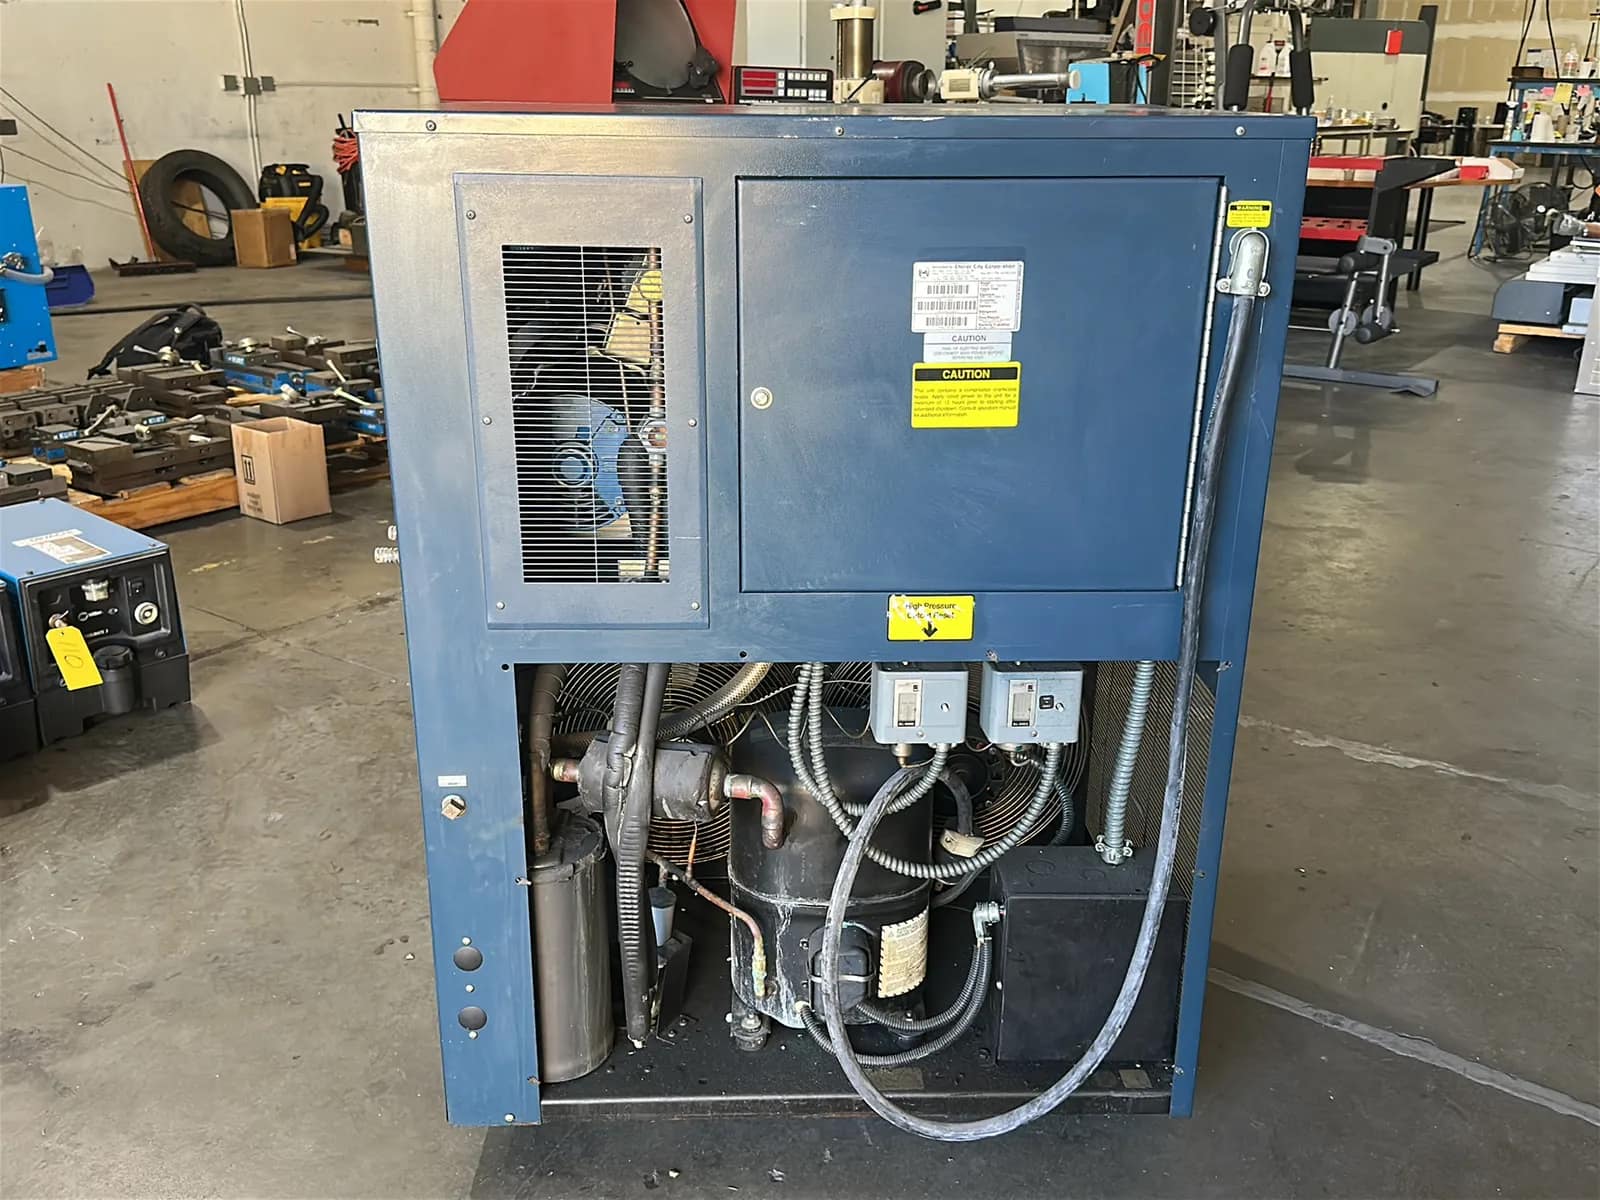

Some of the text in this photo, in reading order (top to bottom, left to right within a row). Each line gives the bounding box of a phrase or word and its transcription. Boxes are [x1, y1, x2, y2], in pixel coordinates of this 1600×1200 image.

[942, 369, 990, 379] CAUTION
[58, 430, 79, 440] KURT
[924, 602, 957, 610] Pressure
